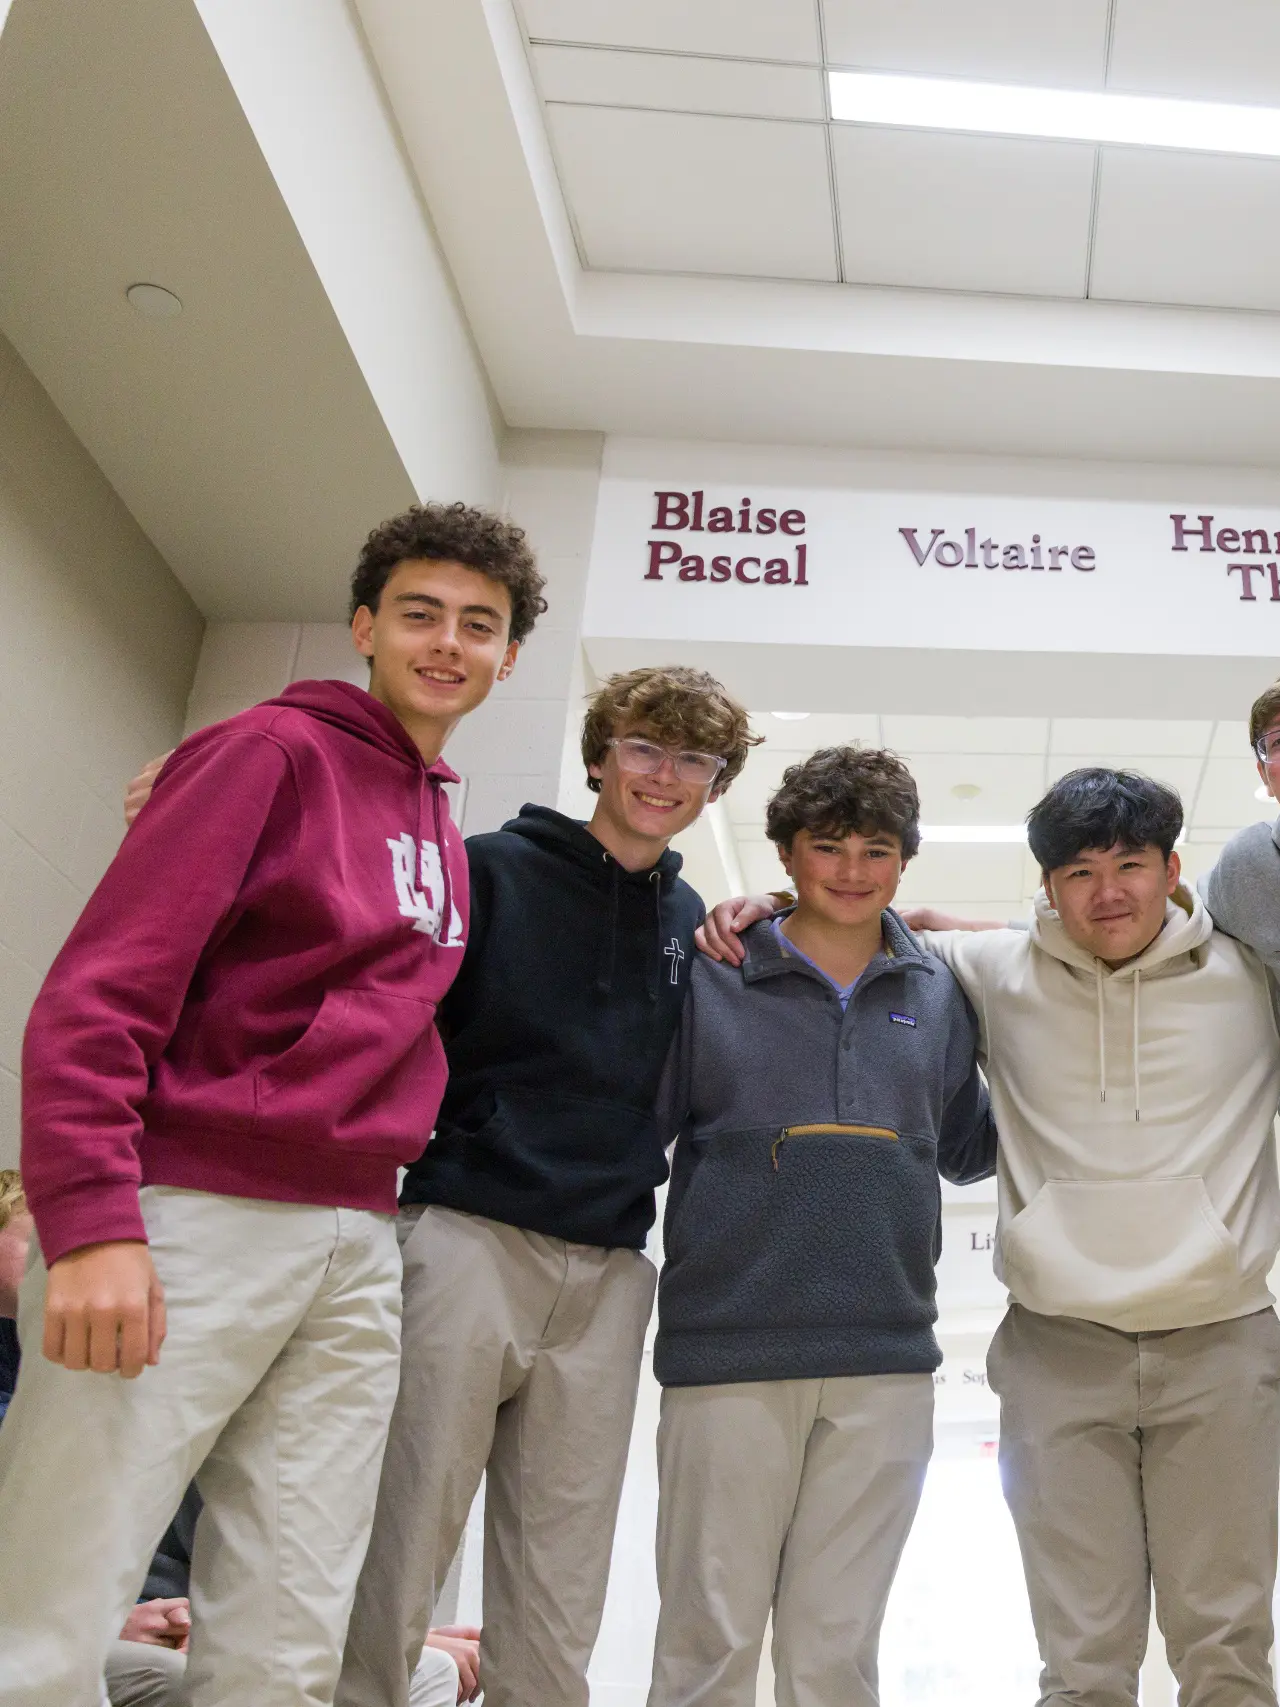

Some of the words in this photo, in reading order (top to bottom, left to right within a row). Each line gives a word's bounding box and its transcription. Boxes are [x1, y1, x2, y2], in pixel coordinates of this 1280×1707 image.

[652, 490, 806, 535] Blaise
[644, 540, 809, 585] Pascal
[899, 527, 1096, 571] Voltaire
